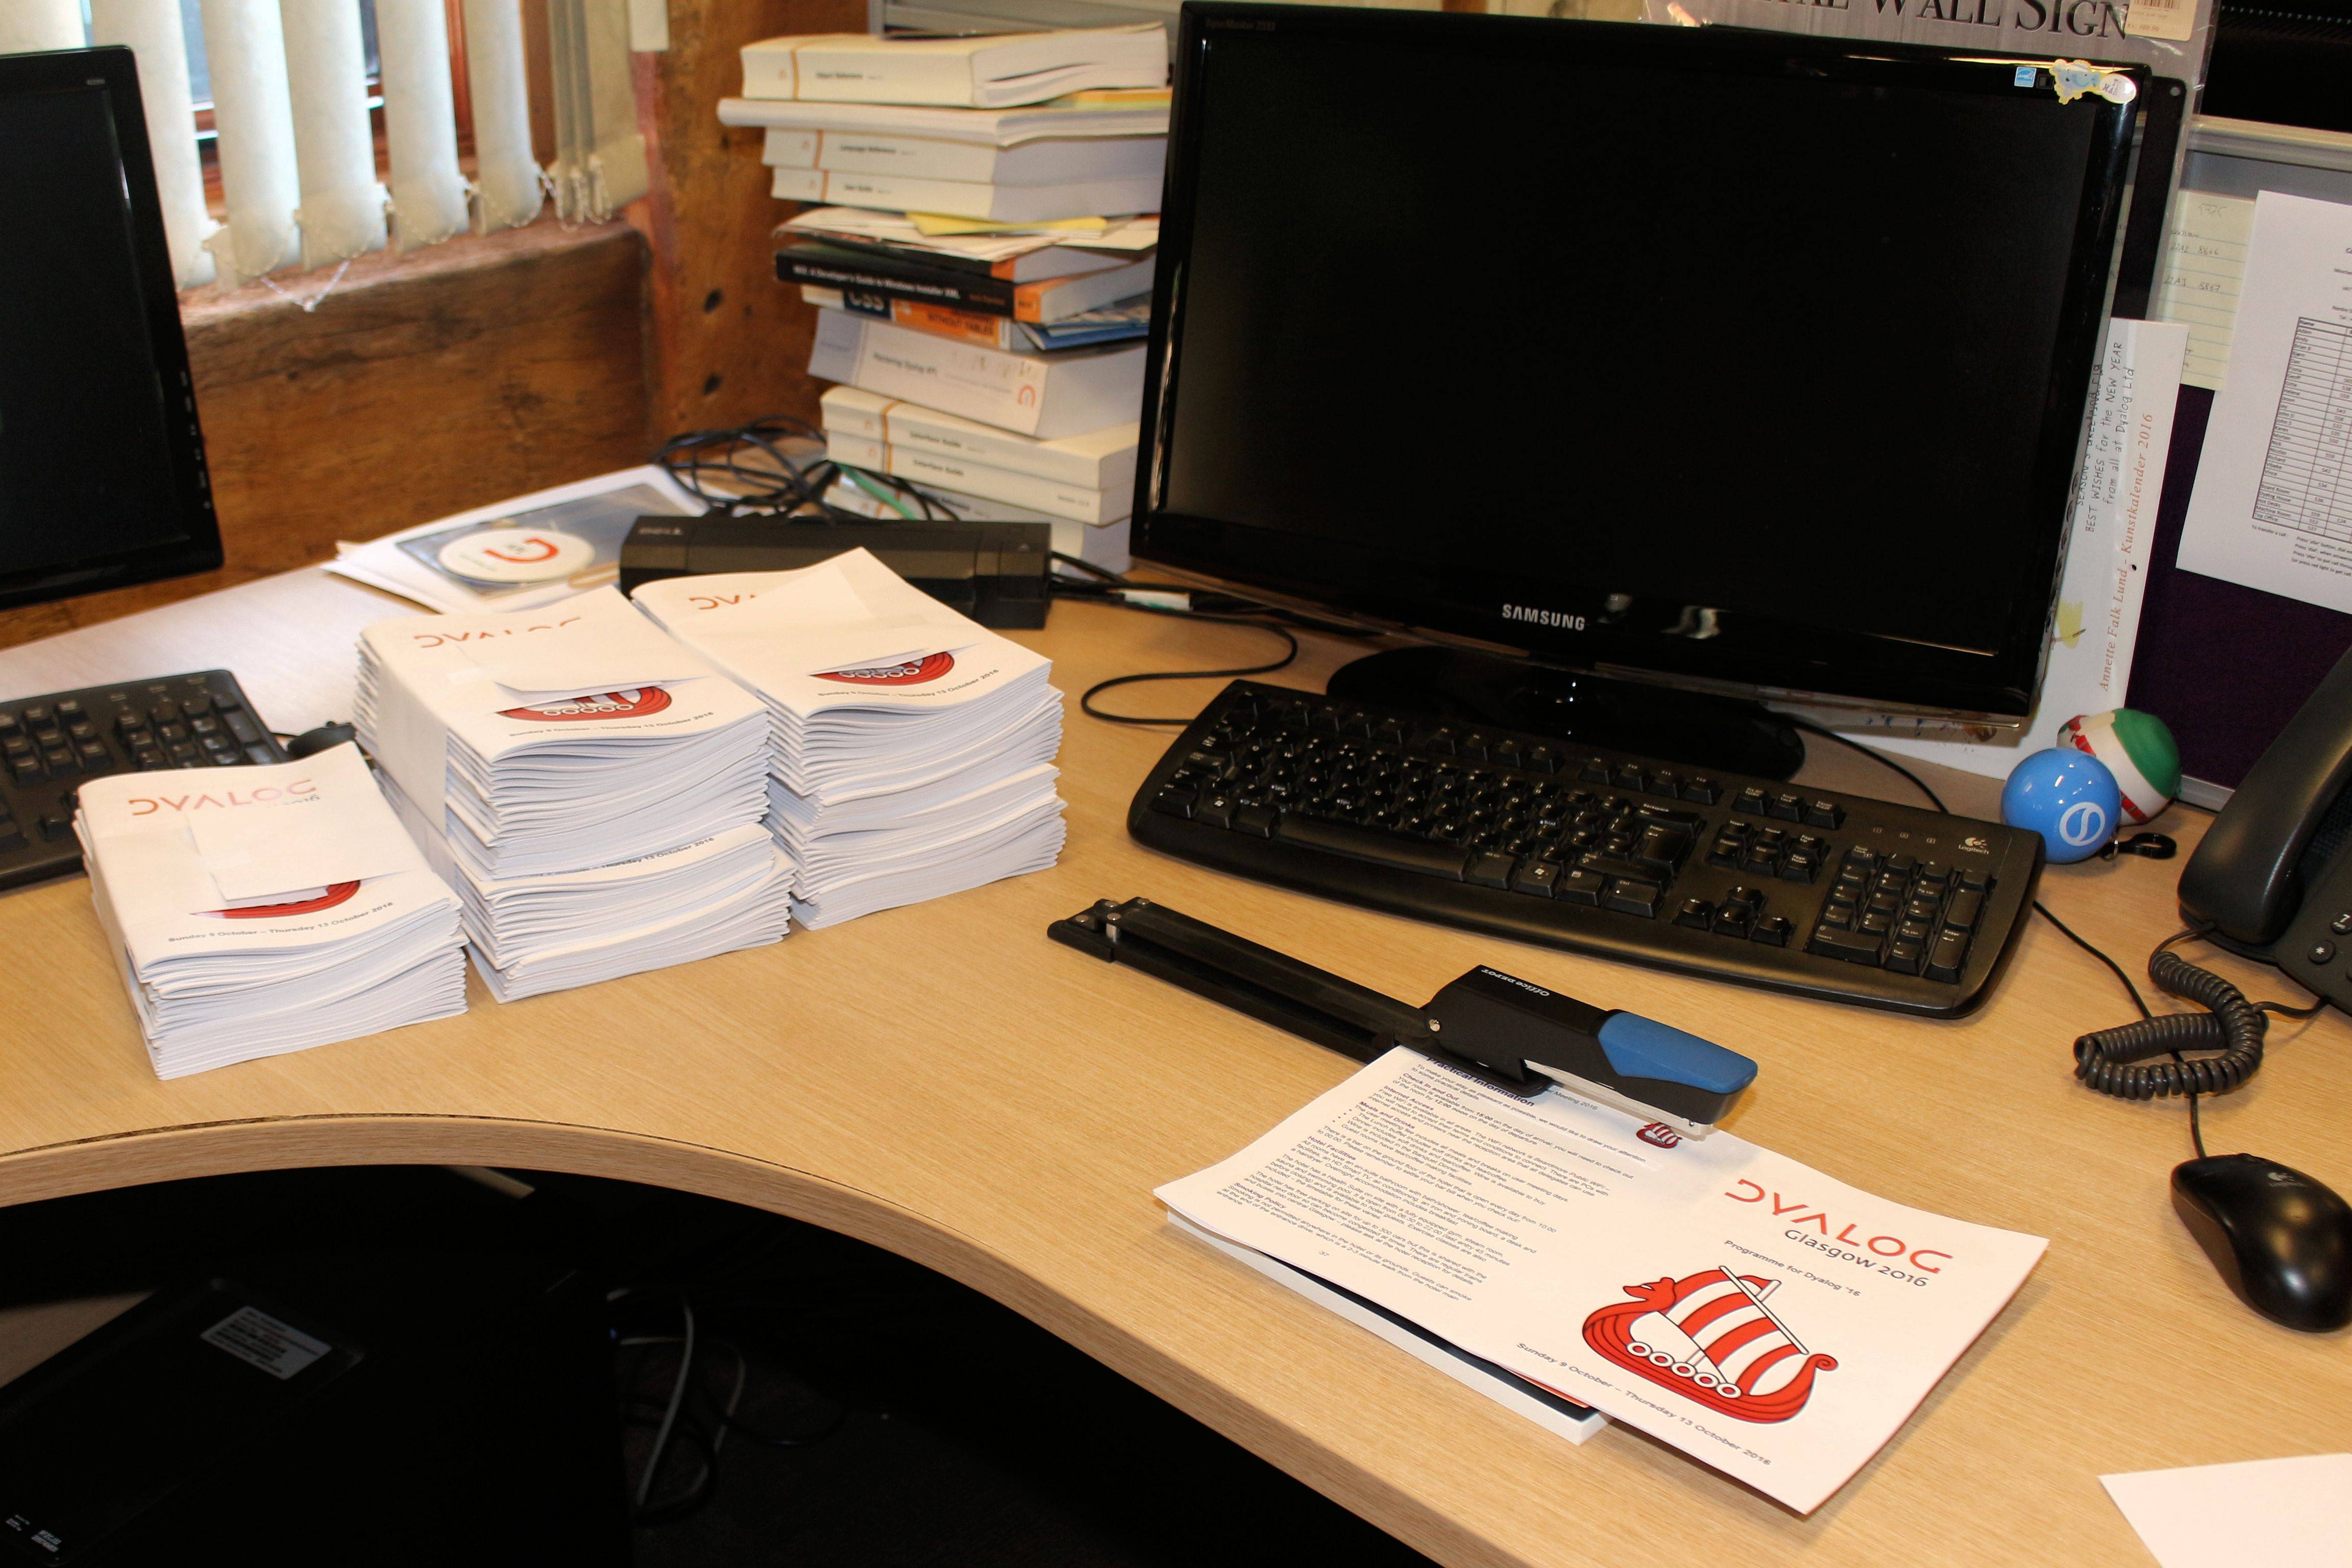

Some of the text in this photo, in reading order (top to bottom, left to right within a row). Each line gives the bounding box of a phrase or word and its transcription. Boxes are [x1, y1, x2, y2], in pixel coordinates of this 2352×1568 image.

[2015, 0, 2129, 39] SIGN
[848, 293, 886, 311] CSS
[2111, 341, 2122, 371] YEAR
[2106, 377, 2117, 403] NEW
[2100, 409, 2113, 428] the
[2138, 412, 2153, 449] 2016
[2096, 433, 2109, 453] for
[2102, 366, 2135, 505] from all at Dyalog Ltd
[2093, 459, 2105, 501] WISHES
[2122, 453, 2147, 554] Kunstkalender
[2086, 505, 2097, 532] BEST
[2113, 568, 2128, 604] Lund
[1502, 603, 1585, 631] SAMSUNG
[2108, 607, 2122, 639] Falk
[947, 678, 980, 692] October
[979, 669, 999, 680] 2016
[2099, 640, 2115, 693] Annette
[656, 718, 692, 727] October
[693, 711, 715, 721] 2016
[129, 779, 317, 816] DYALOG
[656, 845, 692, 858] October
[694, 837, 715, 847] 2016
[1958, 844, 1990, 855] Logitech
[167, 932, 206, 943] Sunday
[269, 925, 315, 935] Thursday
[331, 912, 370, 926] October
[372, 901, 394, 914] 2016
[2339, 914, 2351, 923] 7
[1481, 969, 1550, 996] Office DEPOT
[1401, 1073, 1426, 1084] Check
[1444, 1093, 1461, 1101] Out
[1417, 1071, 1436, 1080] some
[1433, 1078, 1461, 1091] practical
[1458, 1089, 1482, 1100] details.
[1427, 1057, 1535, 1107] Practical Information
[1382, 1085, 1436, 1111] Internet Access
[1554, 1091, 1599, 1111] Meeting 2016
[1357, 1101, 1381, 1112] Meals
[1391, 1117, 1417, 1129] Drinks
[1423, 1068, 1443, 1077] make
[1476, 1092, 1504, 1105] pleasant
[1510, 1107, 1538, 1119] possible,
[1548, 1122, 1568, 1131] would
[1586, 1137, 1604, 1146] draw
[1601, 1143, 1619, 1152] your
[1617, 1149, 1647, 1163] attention
[1475, 1112, 1494, 1121] 15:00
[1306, 1136, 1359, 1161] Hotel Facilities
[1231, 1182, 1288, 1209] Smoking Policy
[1725, 1179, 1953, 1274] DYALOG
[1724, 1240, 1785, 1268] Programme
[1786, 1265, 1803, 1276] for
[1803, 1272, 1842, 1291] Dyalog
[1784, 1229, 1930, 1287] Glasgow 2016
[1517, 1342, 1558, 1363] Sunday
[1568, 1365, 1614, 1388] October
[1625, 1390, 1678, 1418] Thursday
[1679, 1417, 1694, 1427] 13
[1695, 1424, 1743, 1451] October
[1743, 1449, 1772, 1466] 2016
